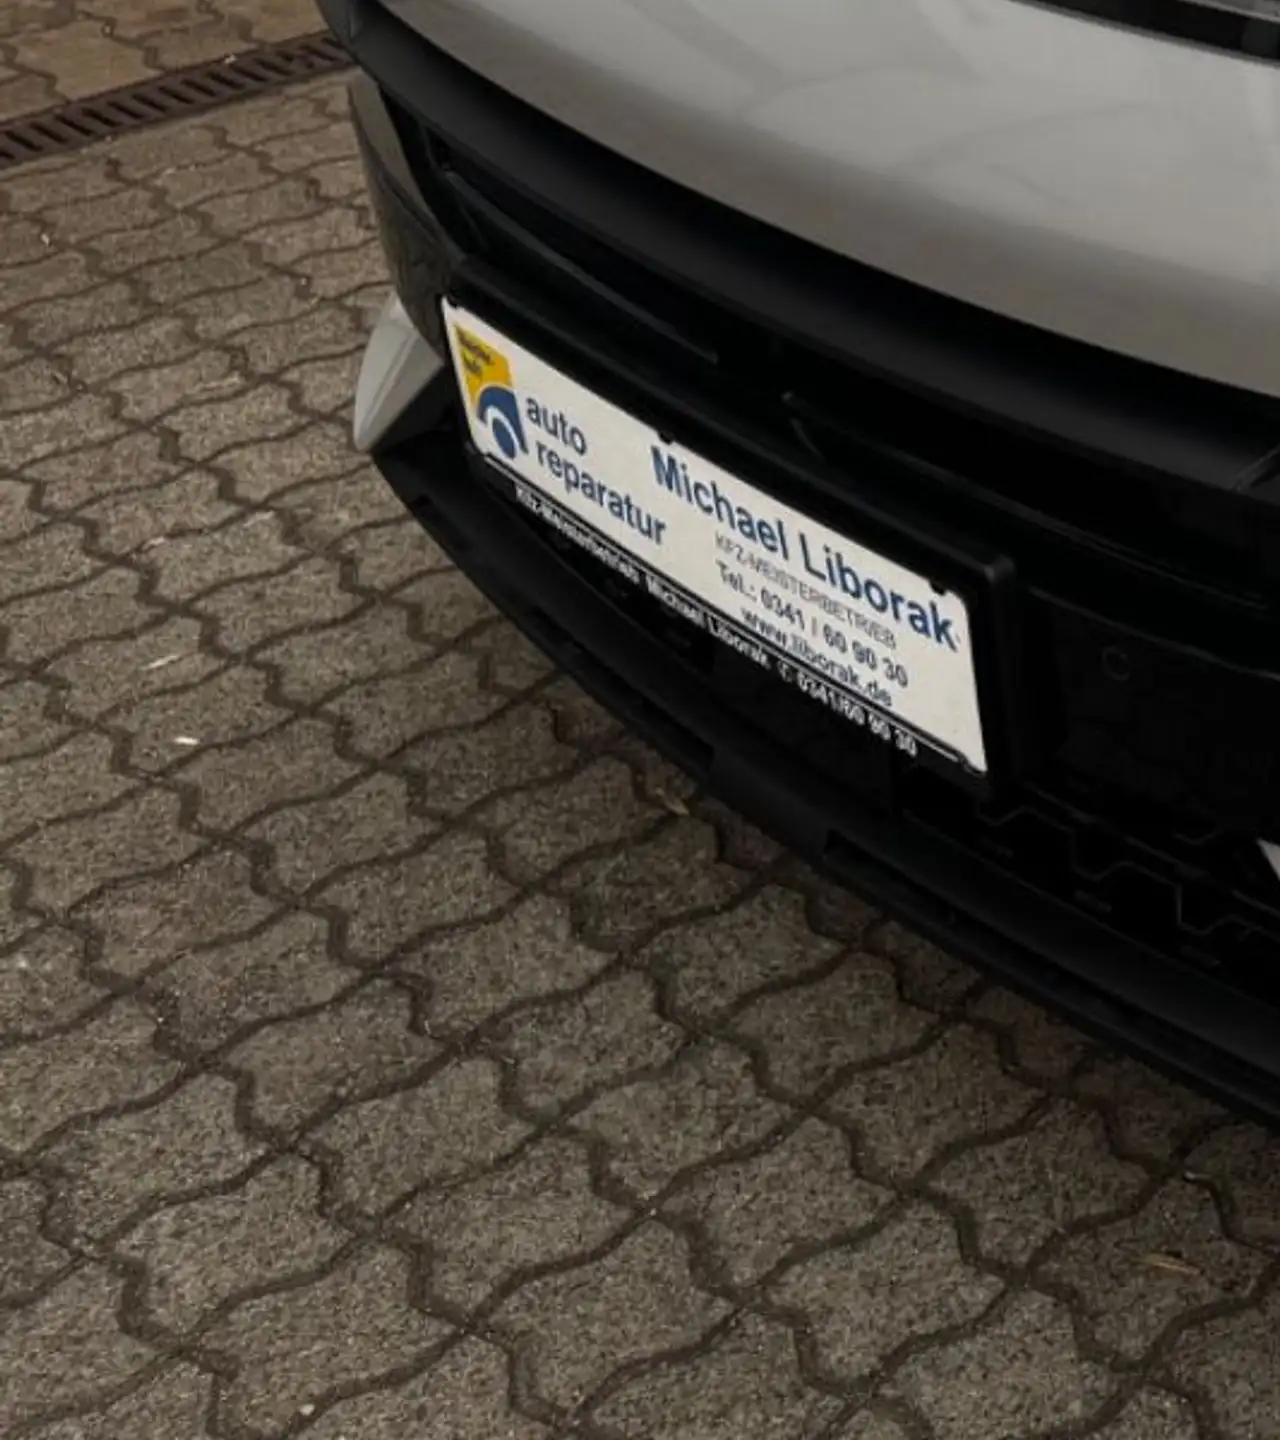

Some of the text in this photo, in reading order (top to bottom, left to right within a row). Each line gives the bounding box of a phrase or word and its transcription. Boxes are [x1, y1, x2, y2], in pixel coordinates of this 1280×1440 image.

[526, 395, 587, 455] auto
[536, 441, 666, 544] reparatur
[651, 445, 957, 652] Michael Liborak
[741, 606, 893, 708] www.liborak.de
[761, 588, 805, 631] 0341
[823, 623, 848, 654] 60
[852, 640, 877, 671] 90
[883, 657, 909, 689] 30
